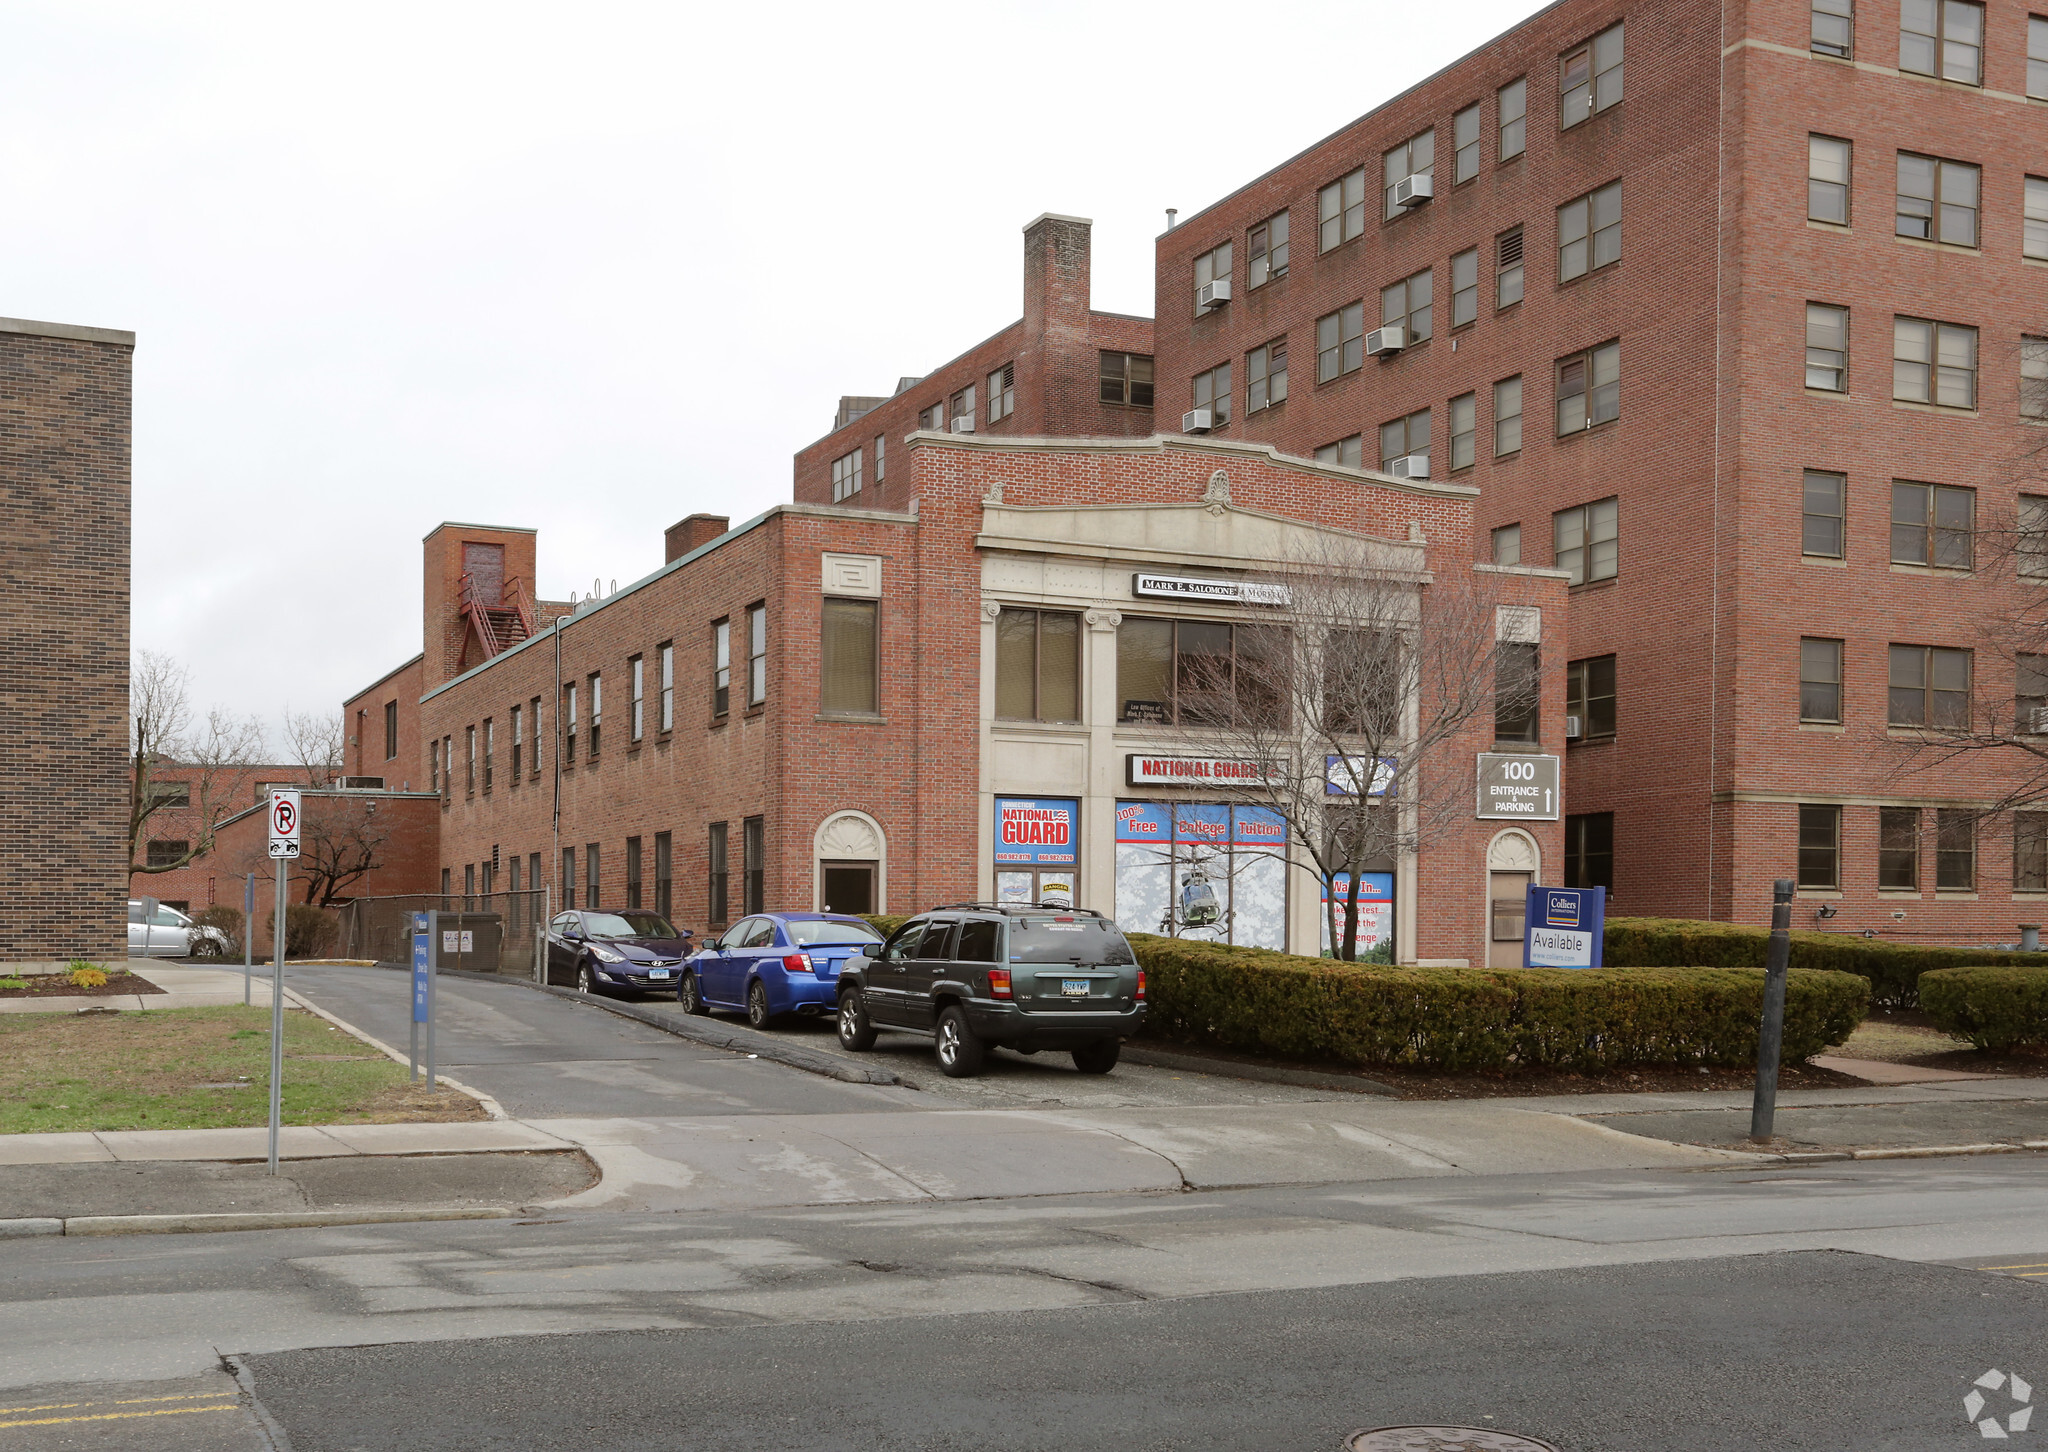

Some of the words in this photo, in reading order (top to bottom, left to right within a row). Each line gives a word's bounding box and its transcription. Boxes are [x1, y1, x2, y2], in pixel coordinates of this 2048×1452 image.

[1145, 580, 1174, 590] MARK
[1177, 583, 1186, 591] E.
[1142, 760, 1210, 777] NATIONAL
[1501, 762, 1535, 780] 100
[1490, 786, 1539, 796] ENTRANCE
[1117, 804, 1144, 821] 100%
[1495, 802, 1535, 812] PARKING
[1002, 809, 1053, 821] NATIONAL
[1002, 821, 1069, 845] GUARD
[1129, 819, 1157, 832] Free
[1179, 820, 1225, 837] College
[1239, 822, 1281, 835] Tuition
[1551, 898, 1576, 909] Colliers
[1363, 919, 1376, 927] the
[1533, 932, 1582, 951] Available
